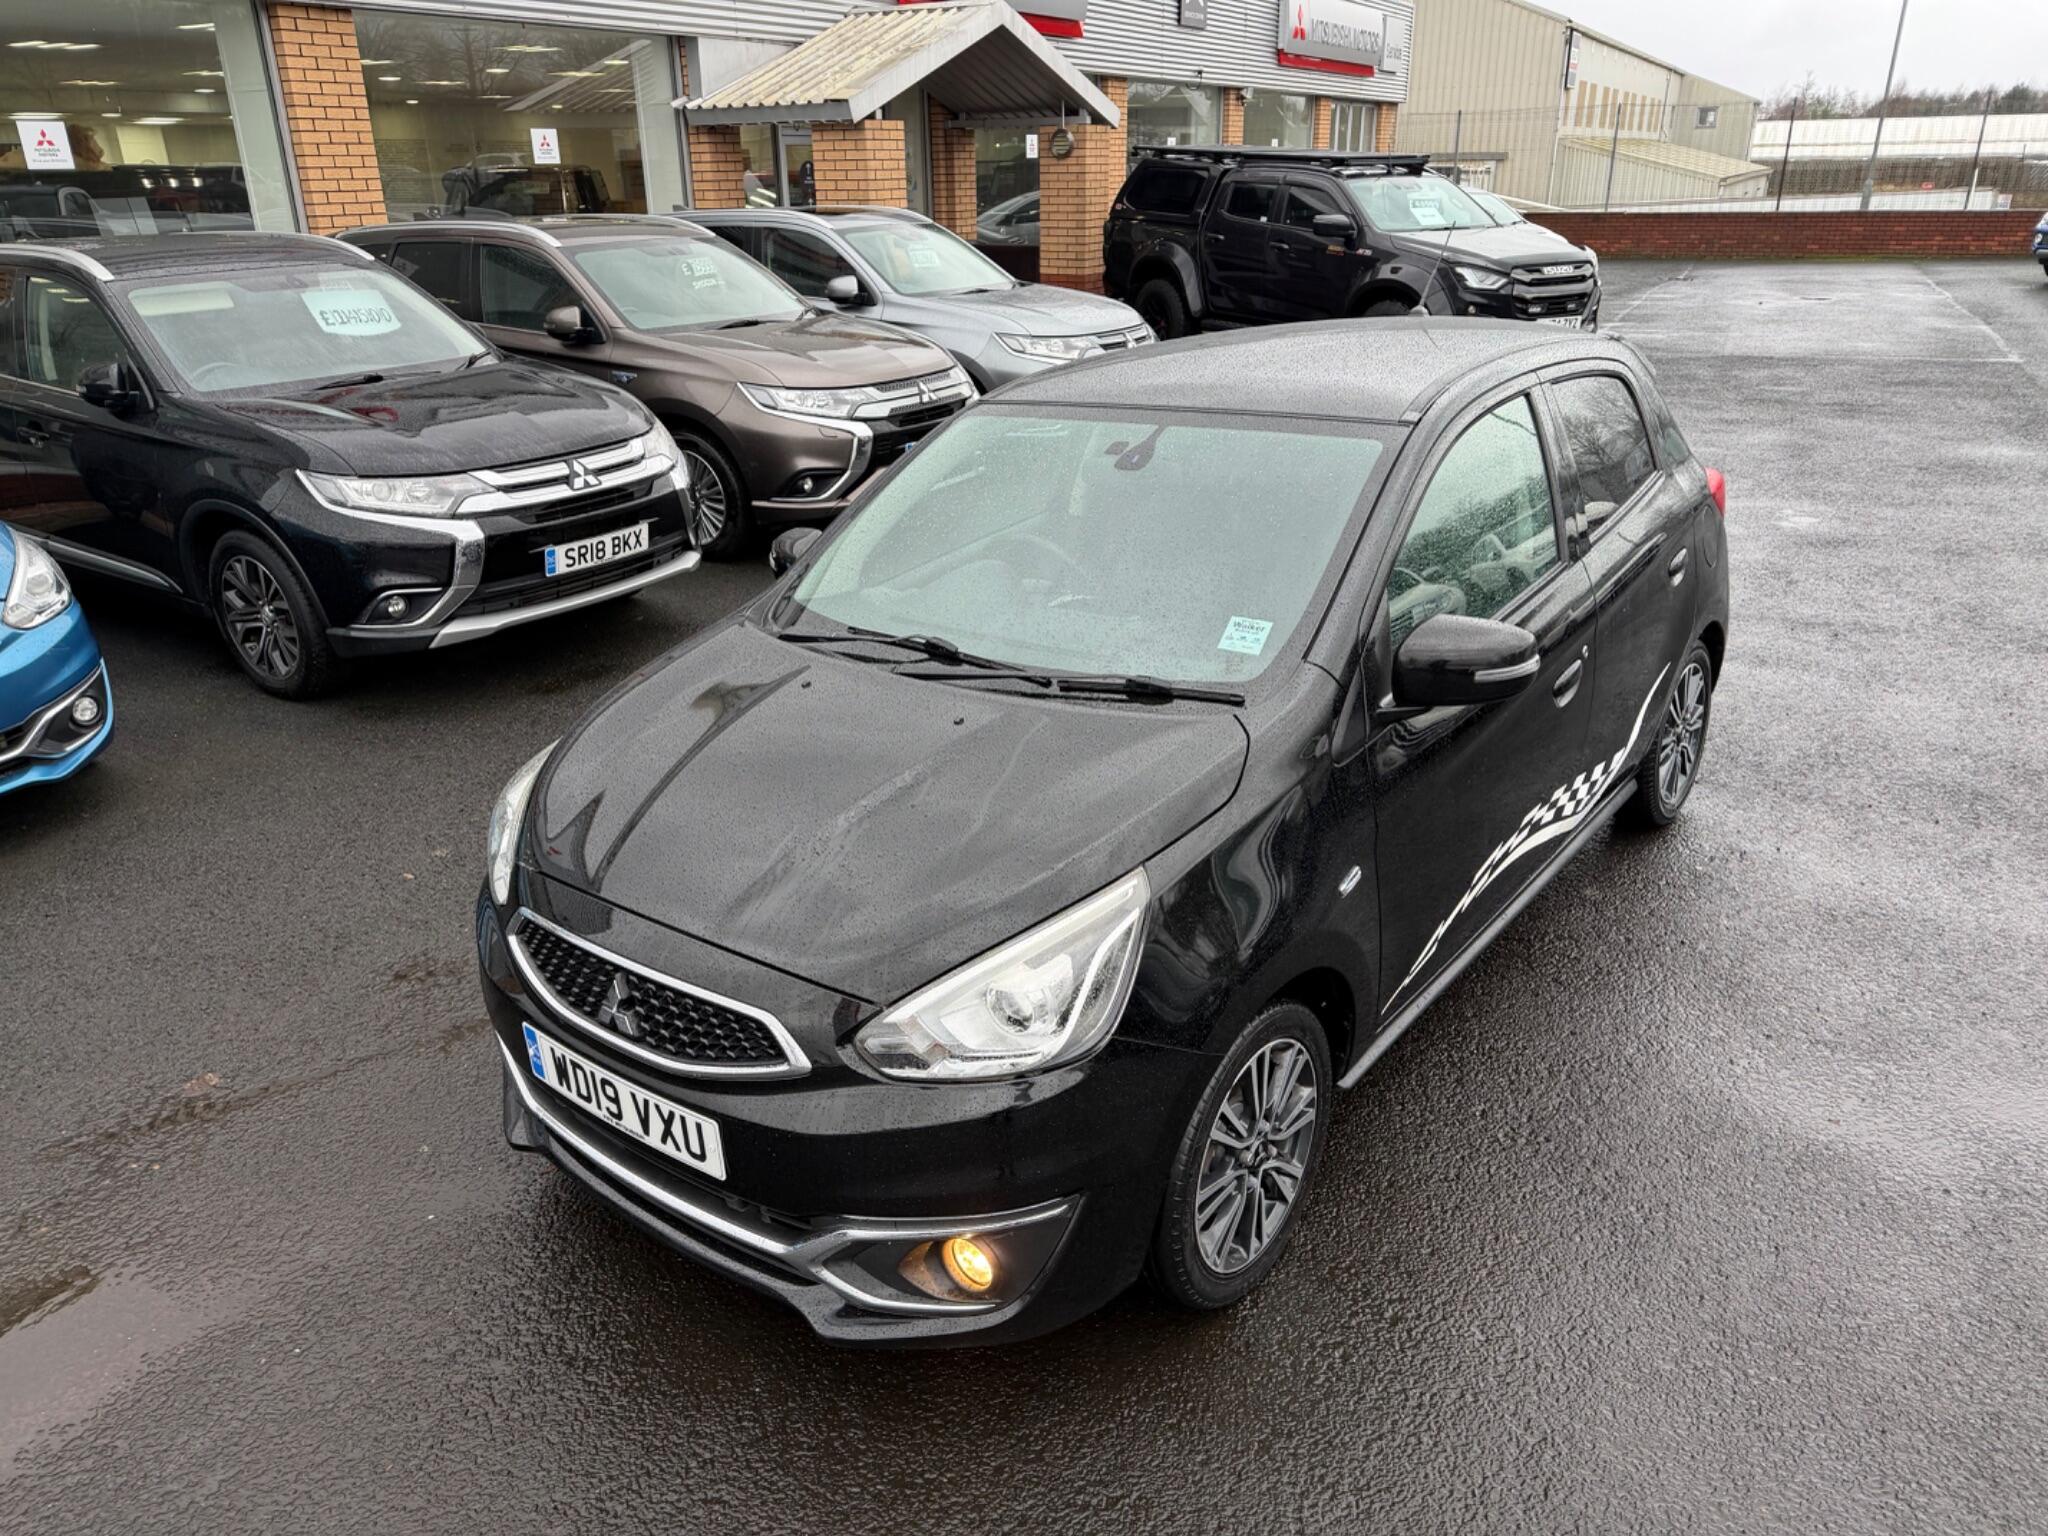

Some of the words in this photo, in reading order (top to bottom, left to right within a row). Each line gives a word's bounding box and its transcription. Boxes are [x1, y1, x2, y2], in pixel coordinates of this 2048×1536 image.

[1543, 265, 1574, 275] ISUZU
[564, 540, 606, 568] SR18
[611, 528, 642, 556] BKX
[551, 1047, 623, 1121] WD19
[630, 1091, 707, 1163] VXU
